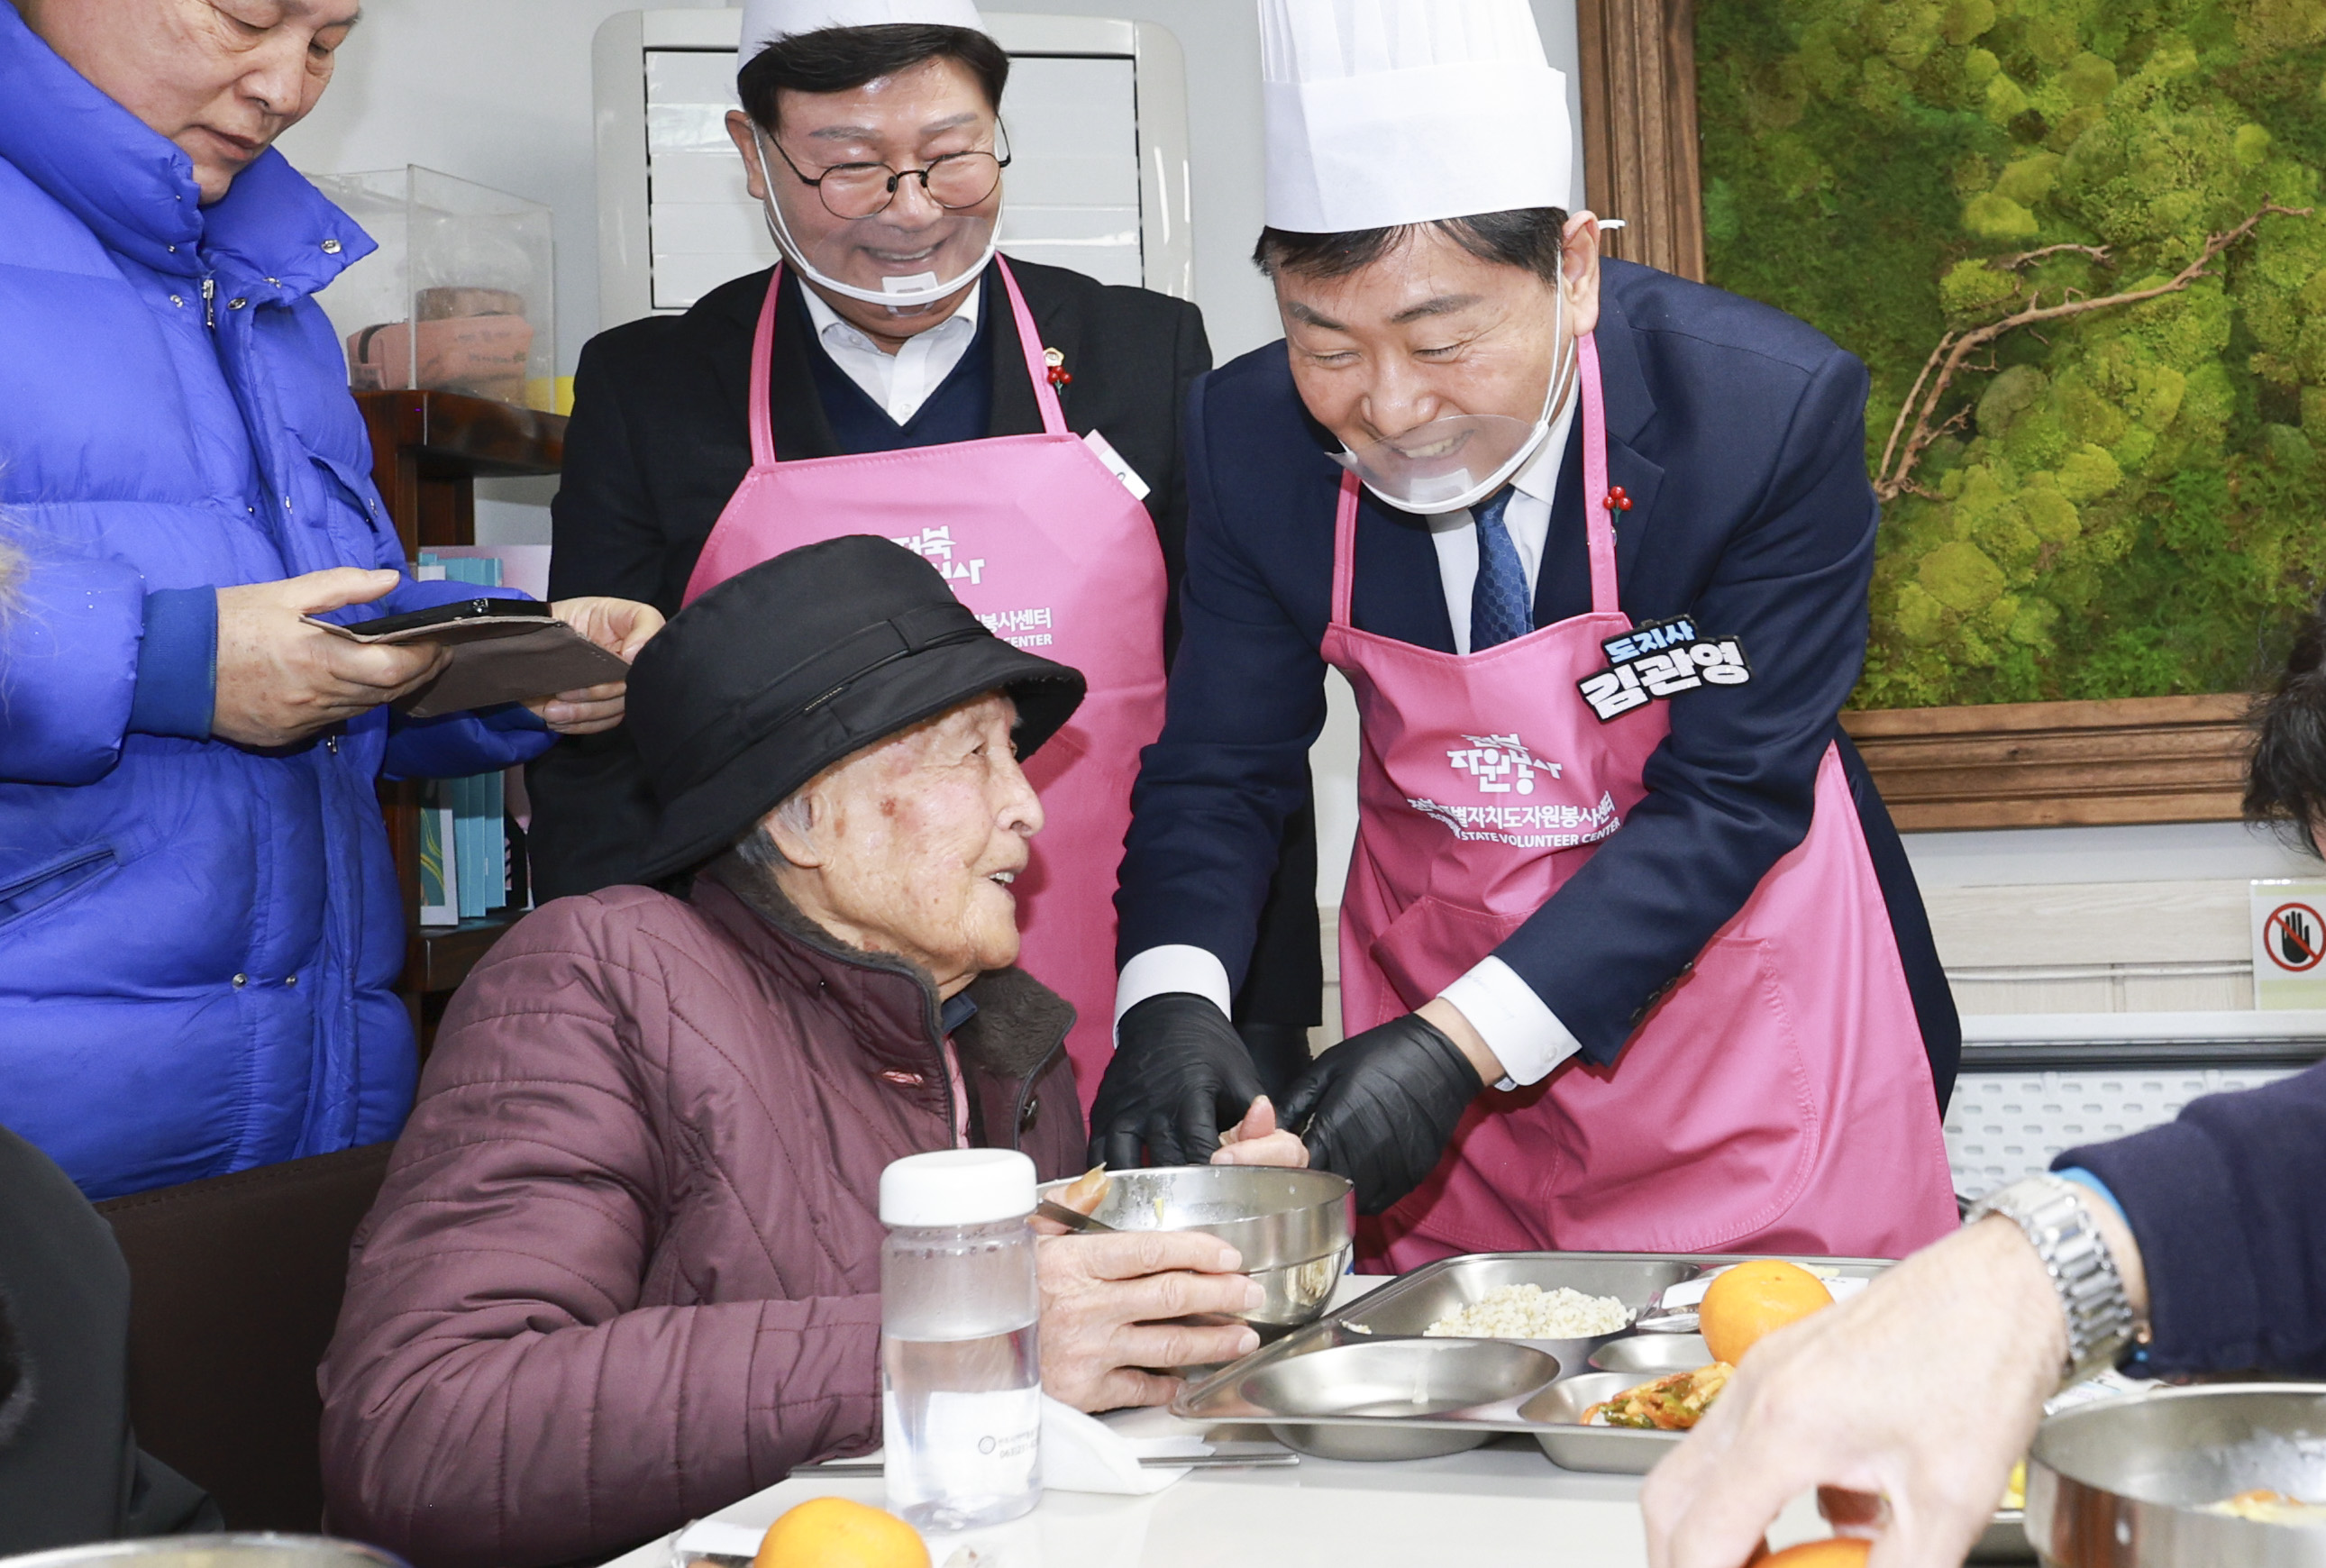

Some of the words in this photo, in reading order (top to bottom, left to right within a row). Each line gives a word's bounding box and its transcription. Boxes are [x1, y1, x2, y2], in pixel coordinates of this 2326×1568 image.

[974, 607, 1052, 634] 봉사센터
[1604, 620, 1696, 664] 도지사
[1580, 641, 1750, 720] 김관영
[1446, 748, 1563, 796] 자원봉사
[1461, 831, 1500, 842] STATE
[1499, 834, 1580, 848] VOLUNTEER
[1582, 816, 1621, 843] CENTER
